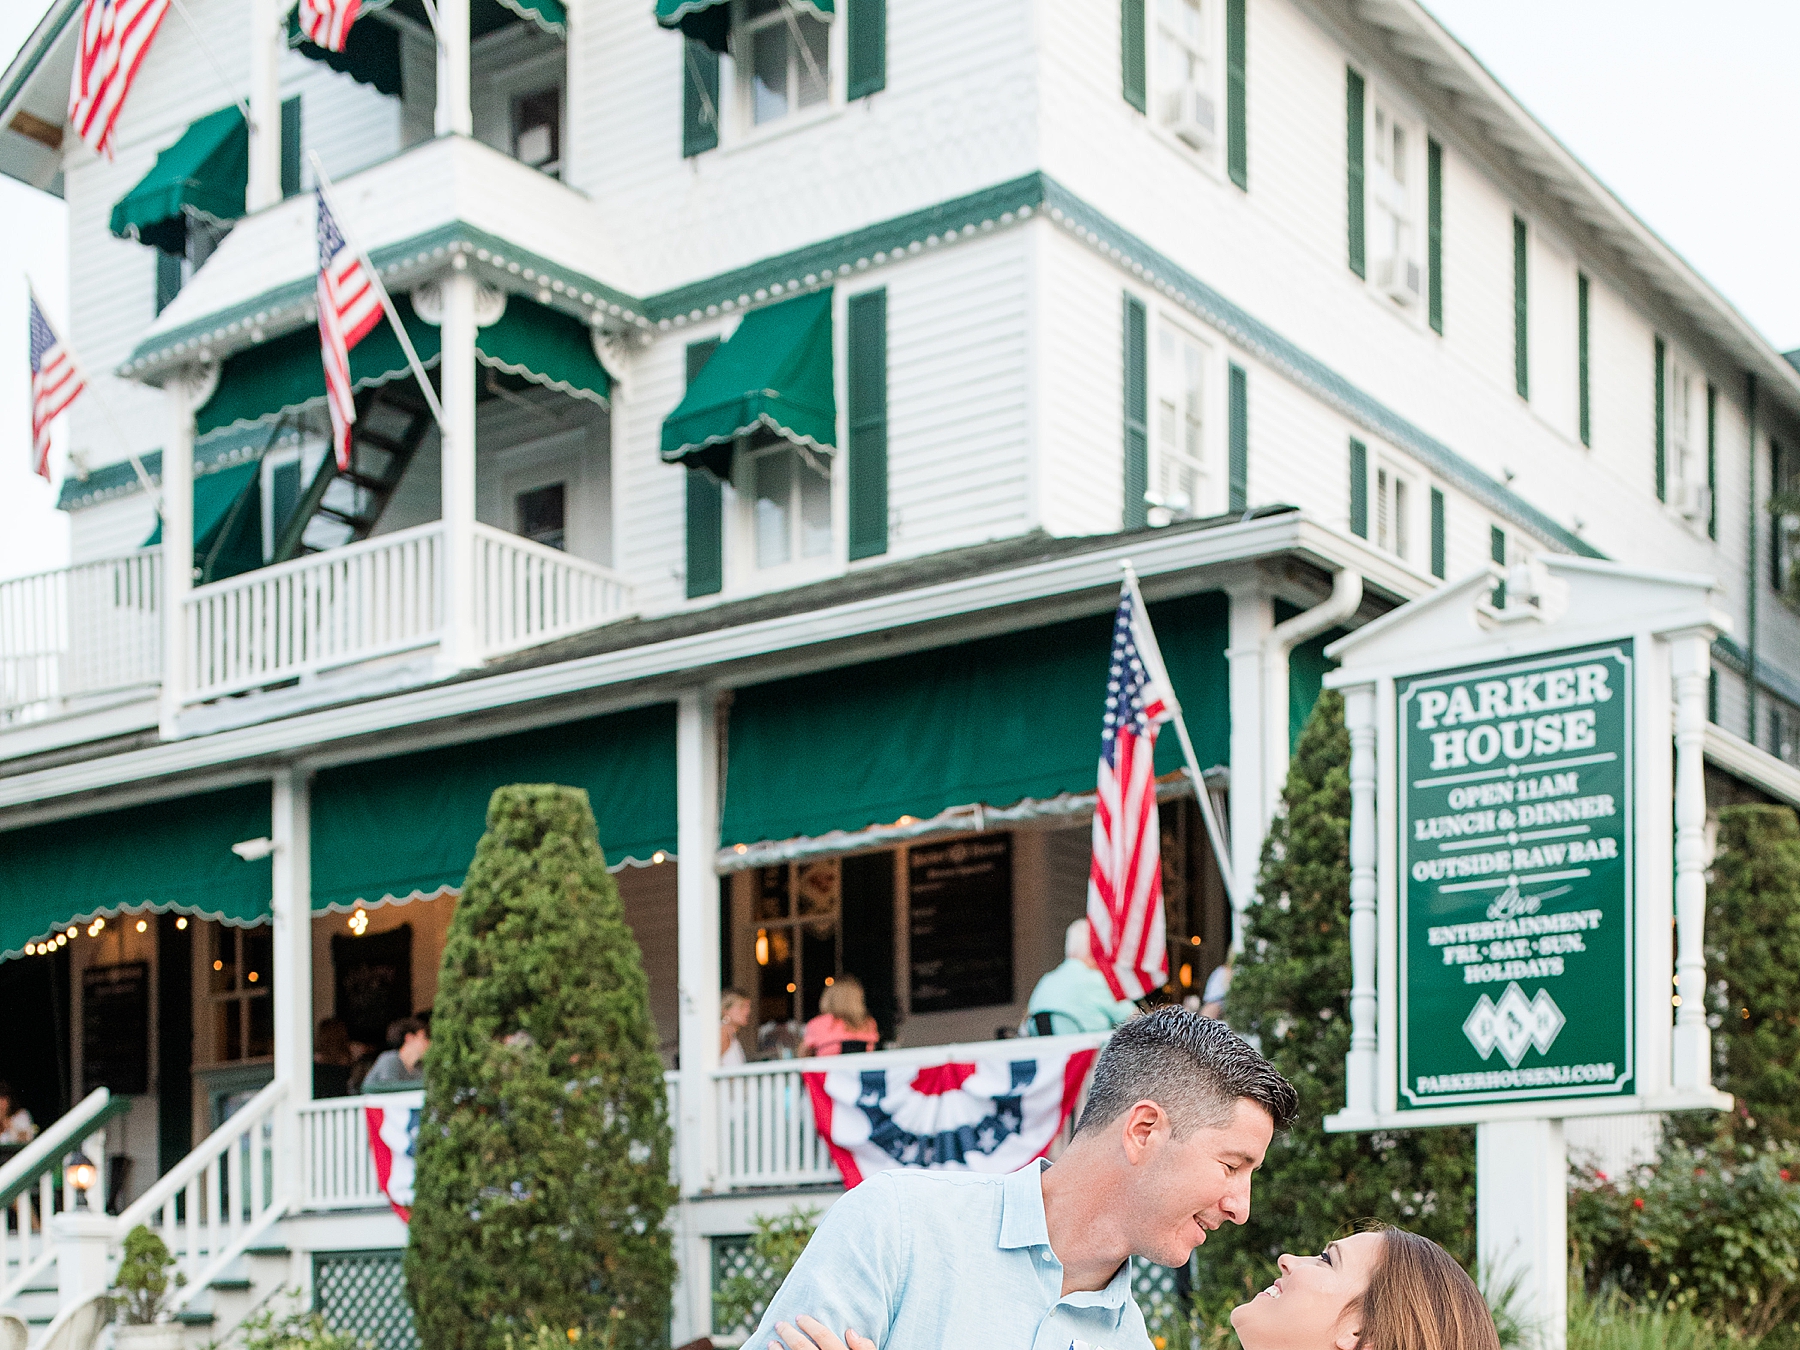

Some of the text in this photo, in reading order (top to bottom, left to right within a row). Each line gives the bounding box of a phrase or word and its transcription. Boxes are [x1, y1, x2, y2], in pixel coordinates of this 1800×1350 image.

[1416, 664, 1613, 730] PARKER
[1430, 709, 1596, 770] HOUSE
[1448, 772, 1579, 810] OPEN 11AM
[1414, 794, 1616, 841] LUNCH & DINNER
[1412, 837, 1618, 882] OUTSIDE RAW BAR
[1428, 909, 1603, 946] ENTERTAINMENT
[1464, 956, 1564, 984] HOLIDAYS
[1416, 1062, 1615, 1093] PARKERHOUSENJ.COM
